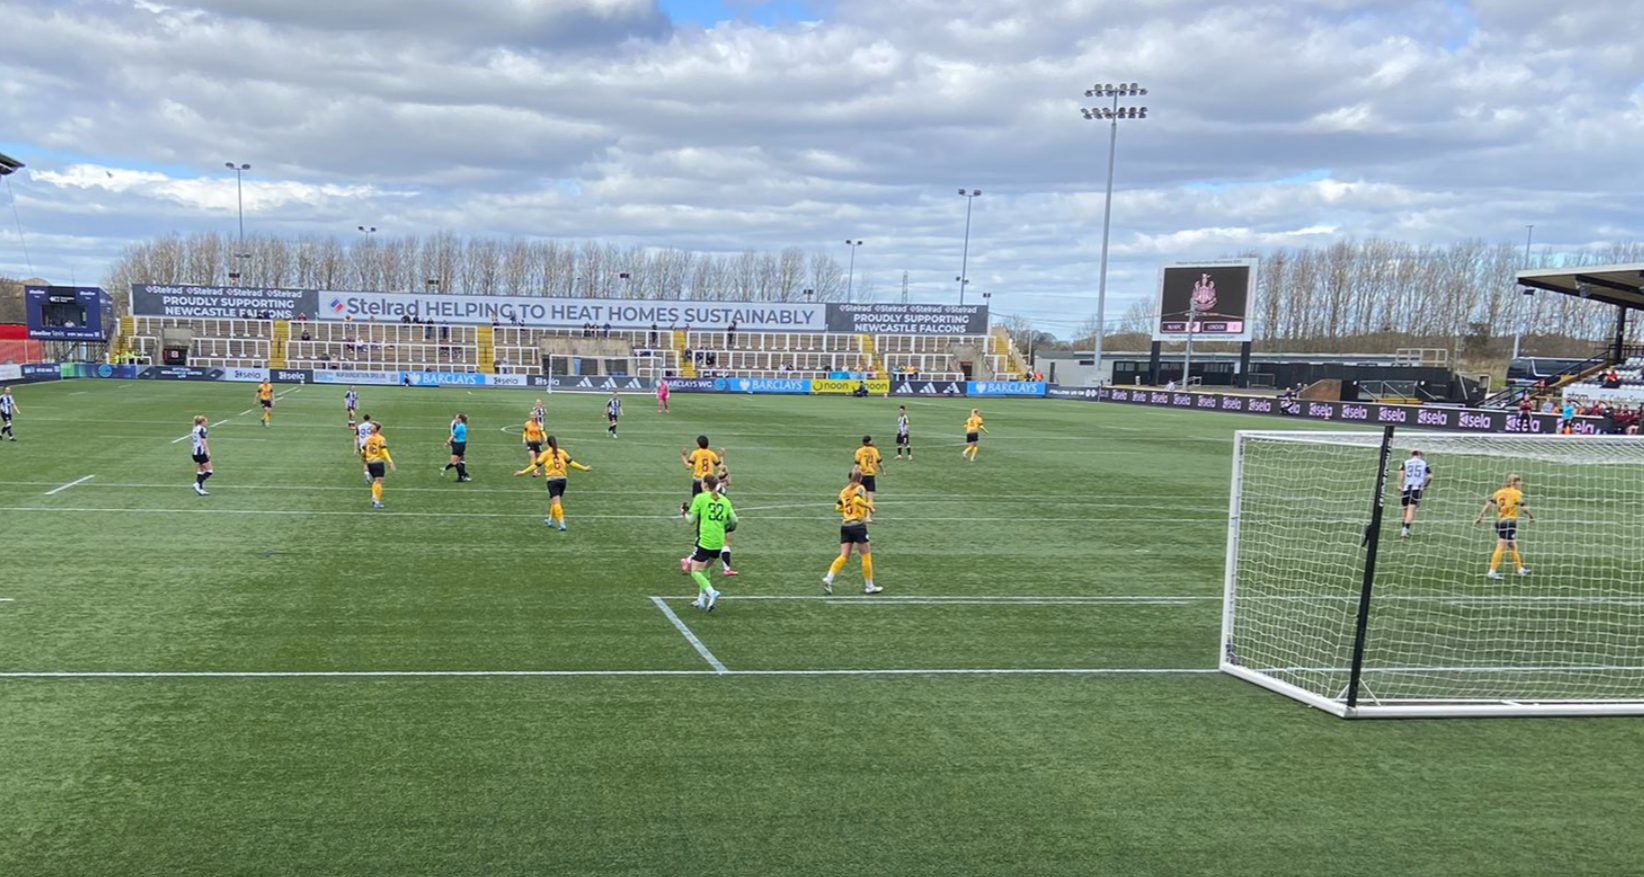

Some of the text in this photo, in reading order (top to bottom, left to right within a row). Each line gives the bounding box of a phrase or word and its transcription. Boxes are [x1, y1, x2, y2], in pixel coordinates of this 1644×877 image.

[152, 285, 183, 295] Stelrad
[193, 286, 223, 295] Stelrad
[233, 288, 263, 297] Stelrad
[273, 289, 302, 298] Stelrad
[163, 296, 295, 309] PROUDLY SUPPORTING
[165, 307, 237, 317] NEWCASTLE
[347, 297, 815, 325] Stelrad HELPING TO HEAT HOMES SUSTAINABLY
[880, 305, 907, 313] Stelrad
[915, 305, 942, 313] Stelrad
[950, 306, 977, 314] Stelrad
[854, 313, 969, 324] PROUDLY SUPPORTING
[854, 323, 966, 333] NEWCASTLE FALCONS
[423, 374, 476, 384] BARCLAYS
[752, 380, 803, 390] BARCLAYS
[823, 382, 849, 390] noon
[987, 382, 1038, 393] BARCLAYS
[701, 458, 709, 472] 8
[1406, 464, 1422, 478] 35
[708, 502, 724, 522] 32
